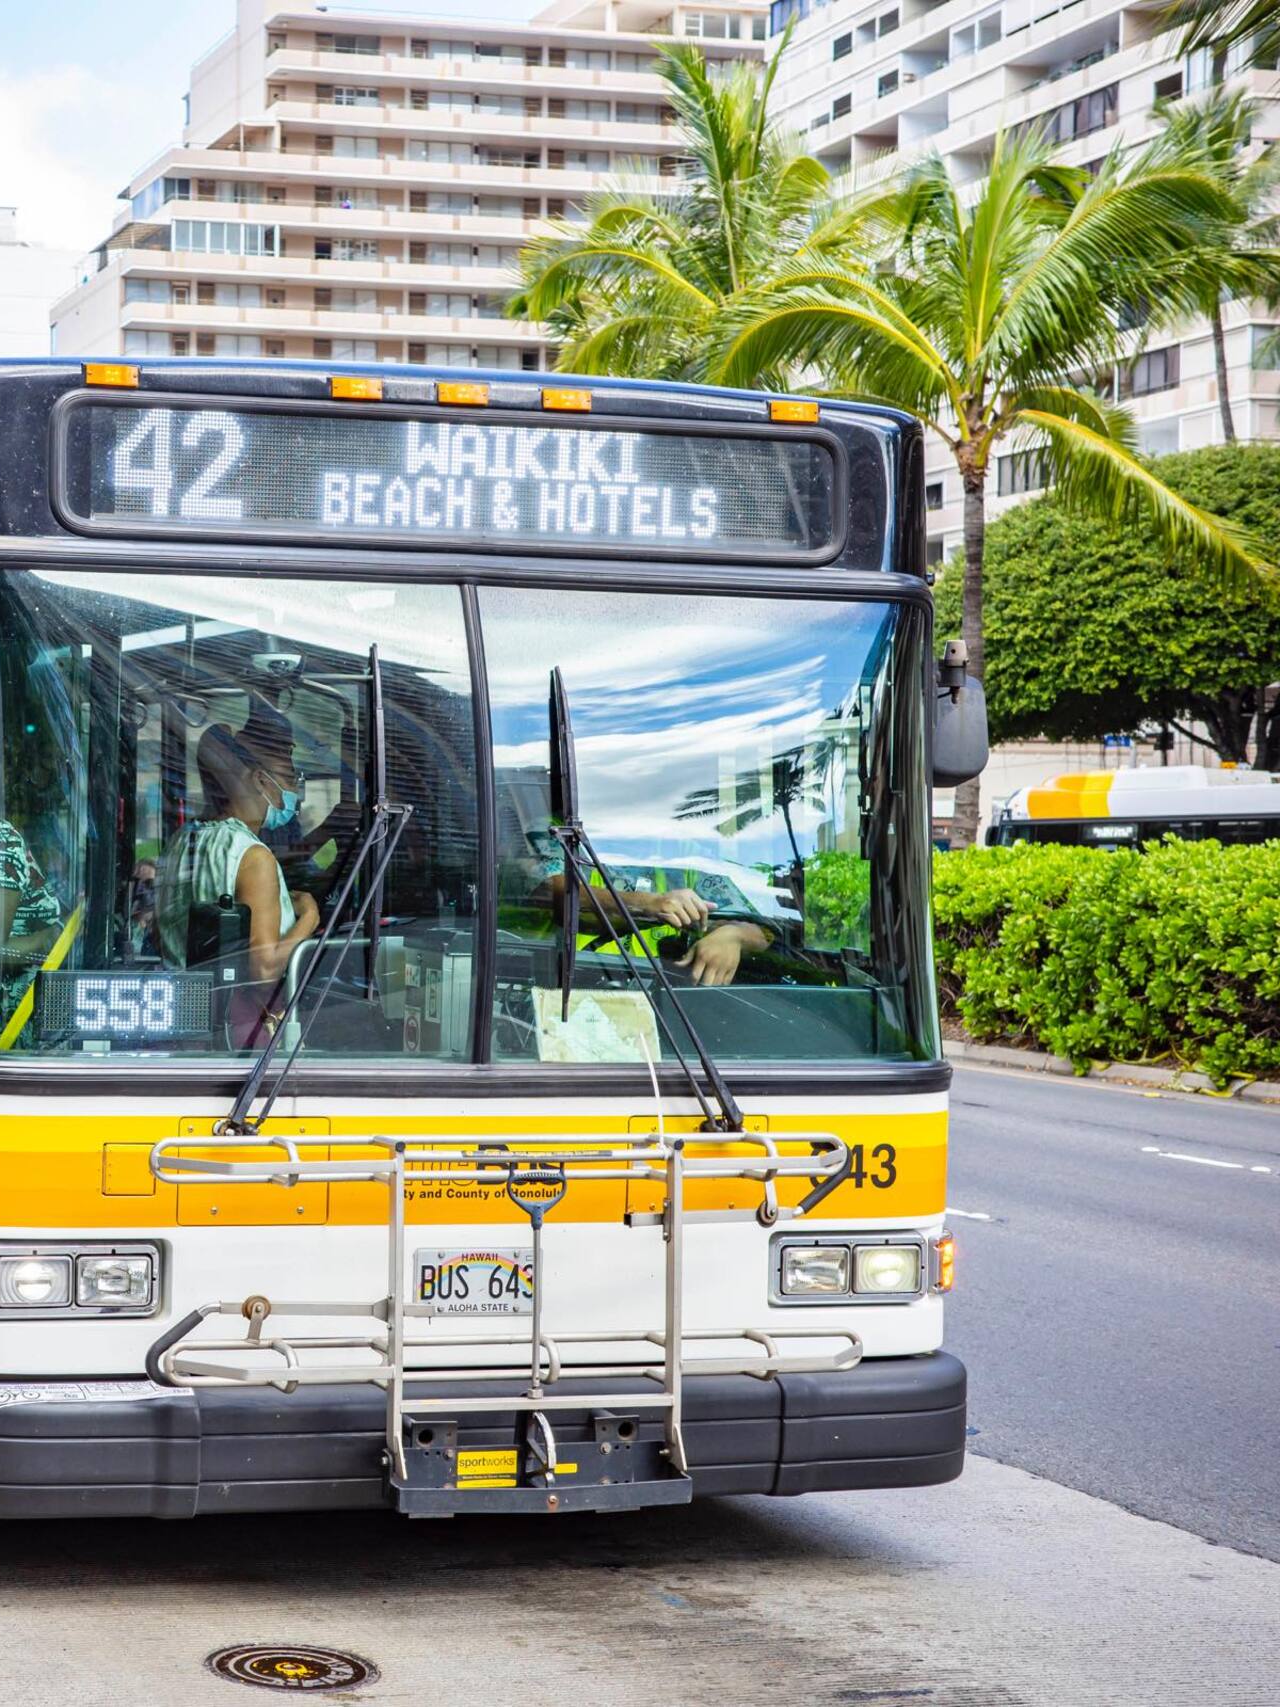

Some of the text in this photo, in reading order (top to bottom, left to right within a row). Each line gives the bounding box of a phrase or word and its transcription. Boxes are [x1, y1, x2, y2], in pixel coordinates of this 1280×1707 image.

[114, 408, 243, 518] 42
[406, 421, 640, 484] WAIKIKI
[323, 473, 718, 538] BEACH & HOTELS
[76, 979, 172, 1031] 558
[404, 1189, 414, 1200] ty
[420, 1189, 442, 1198] and
[447, 1189, 489, 1200] County
[495, 1189, 506, 1198] of
[461, 1253, 499, 1262] HAWAII
[421, 1264, 533, 1300] BUS 643
[448, 1303, 509, 1312] ALOHA STATE
[459, 1456, 515, 1468] sportworks
